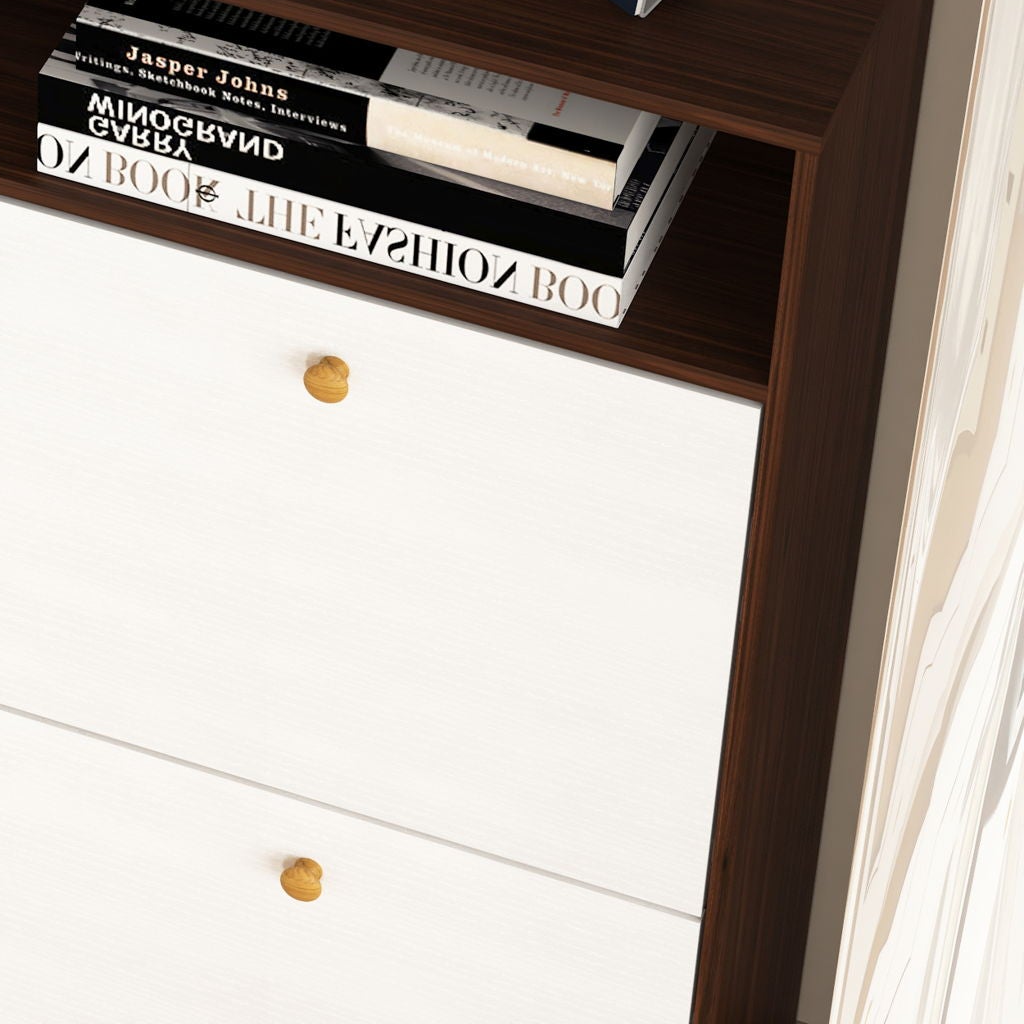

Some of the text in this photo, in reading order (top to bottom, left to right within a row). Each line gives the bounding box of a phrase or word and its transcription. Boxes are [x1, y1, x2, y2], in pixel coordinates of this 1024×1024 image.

[126, 45, 289, 102] Jasper Johns
[138, 68, 217, 98] Sketchbook
[270, 103, 348, 134] Interviews
